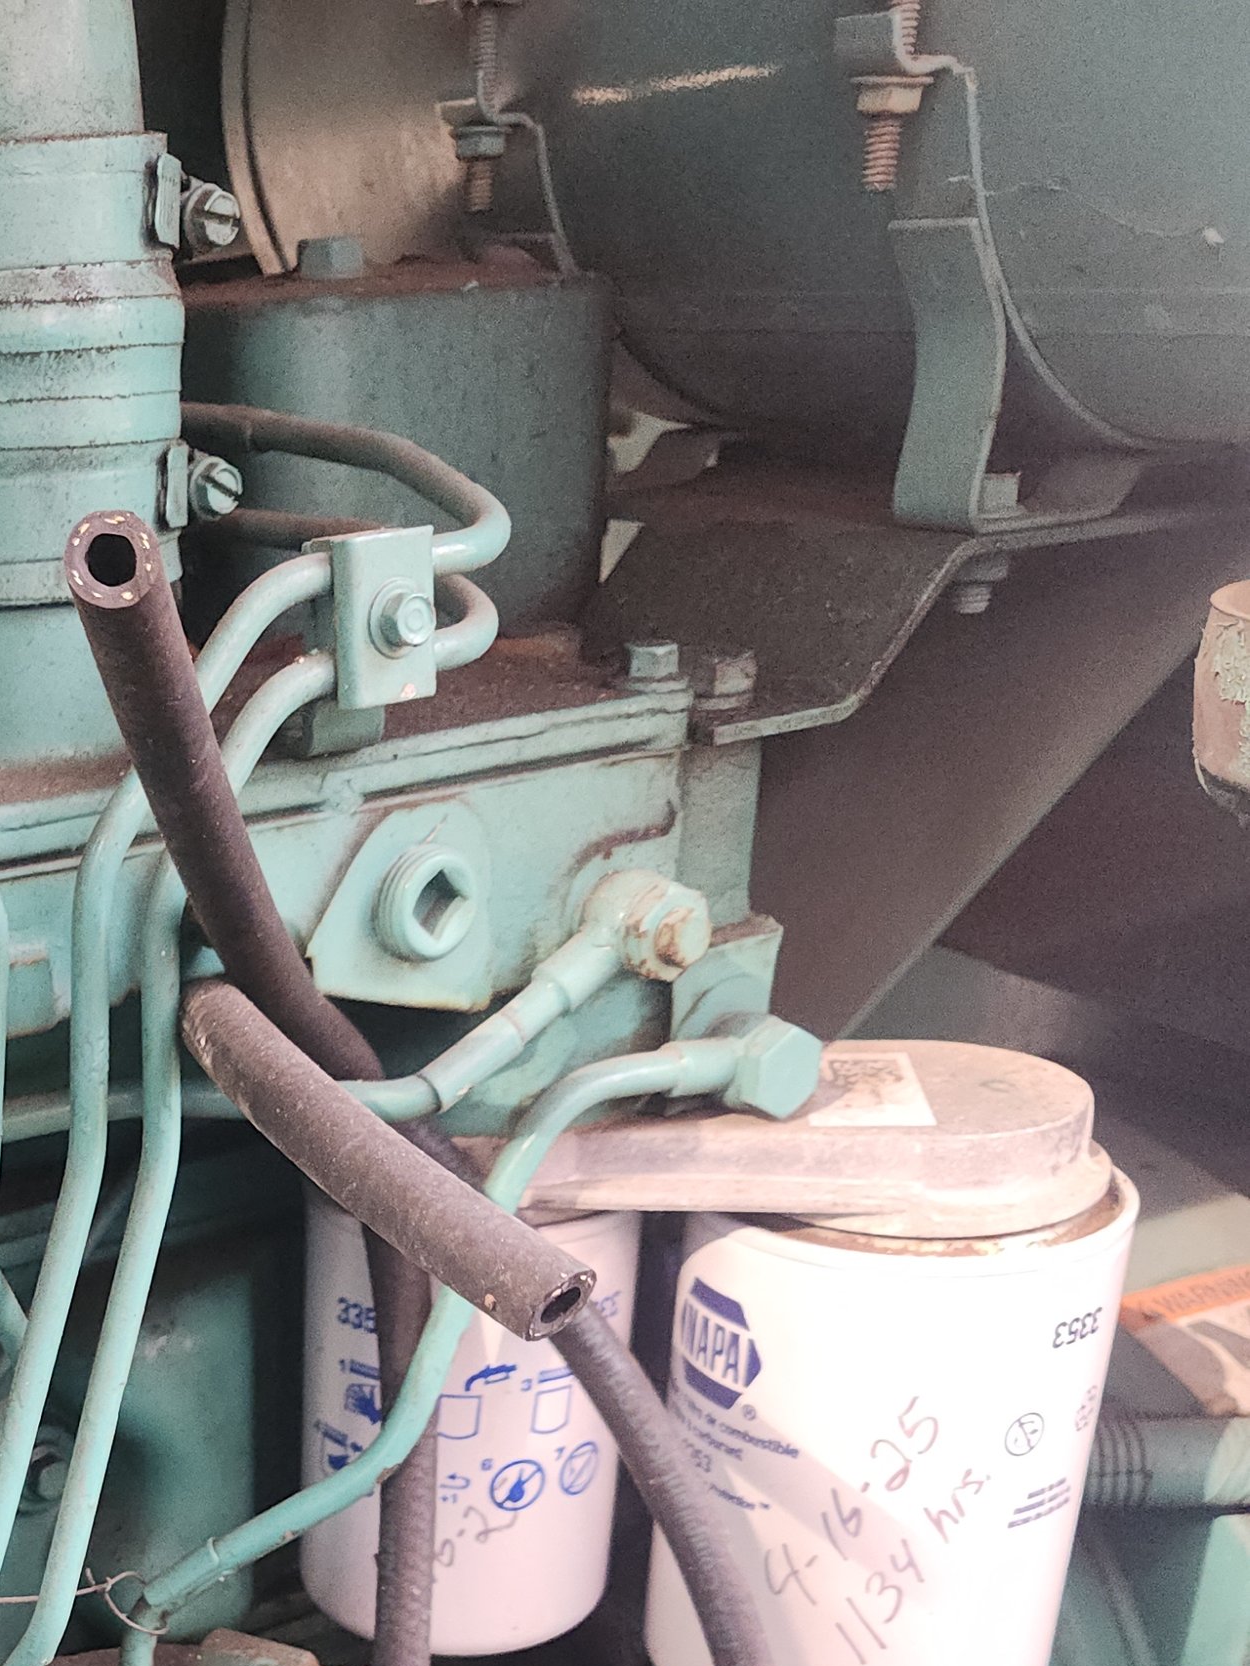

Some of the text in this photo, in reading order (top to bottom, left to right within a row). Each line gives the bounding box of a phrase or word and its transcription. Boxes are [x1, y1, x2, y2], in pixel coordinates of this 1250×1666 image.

[682, 1300, 740, 1386] NAPA
[1052, 1306, 1102, 1349] 3353
[764, 1396, 939, 1606] 4-16-25
[835, 1538, 925, 1665] 1134
